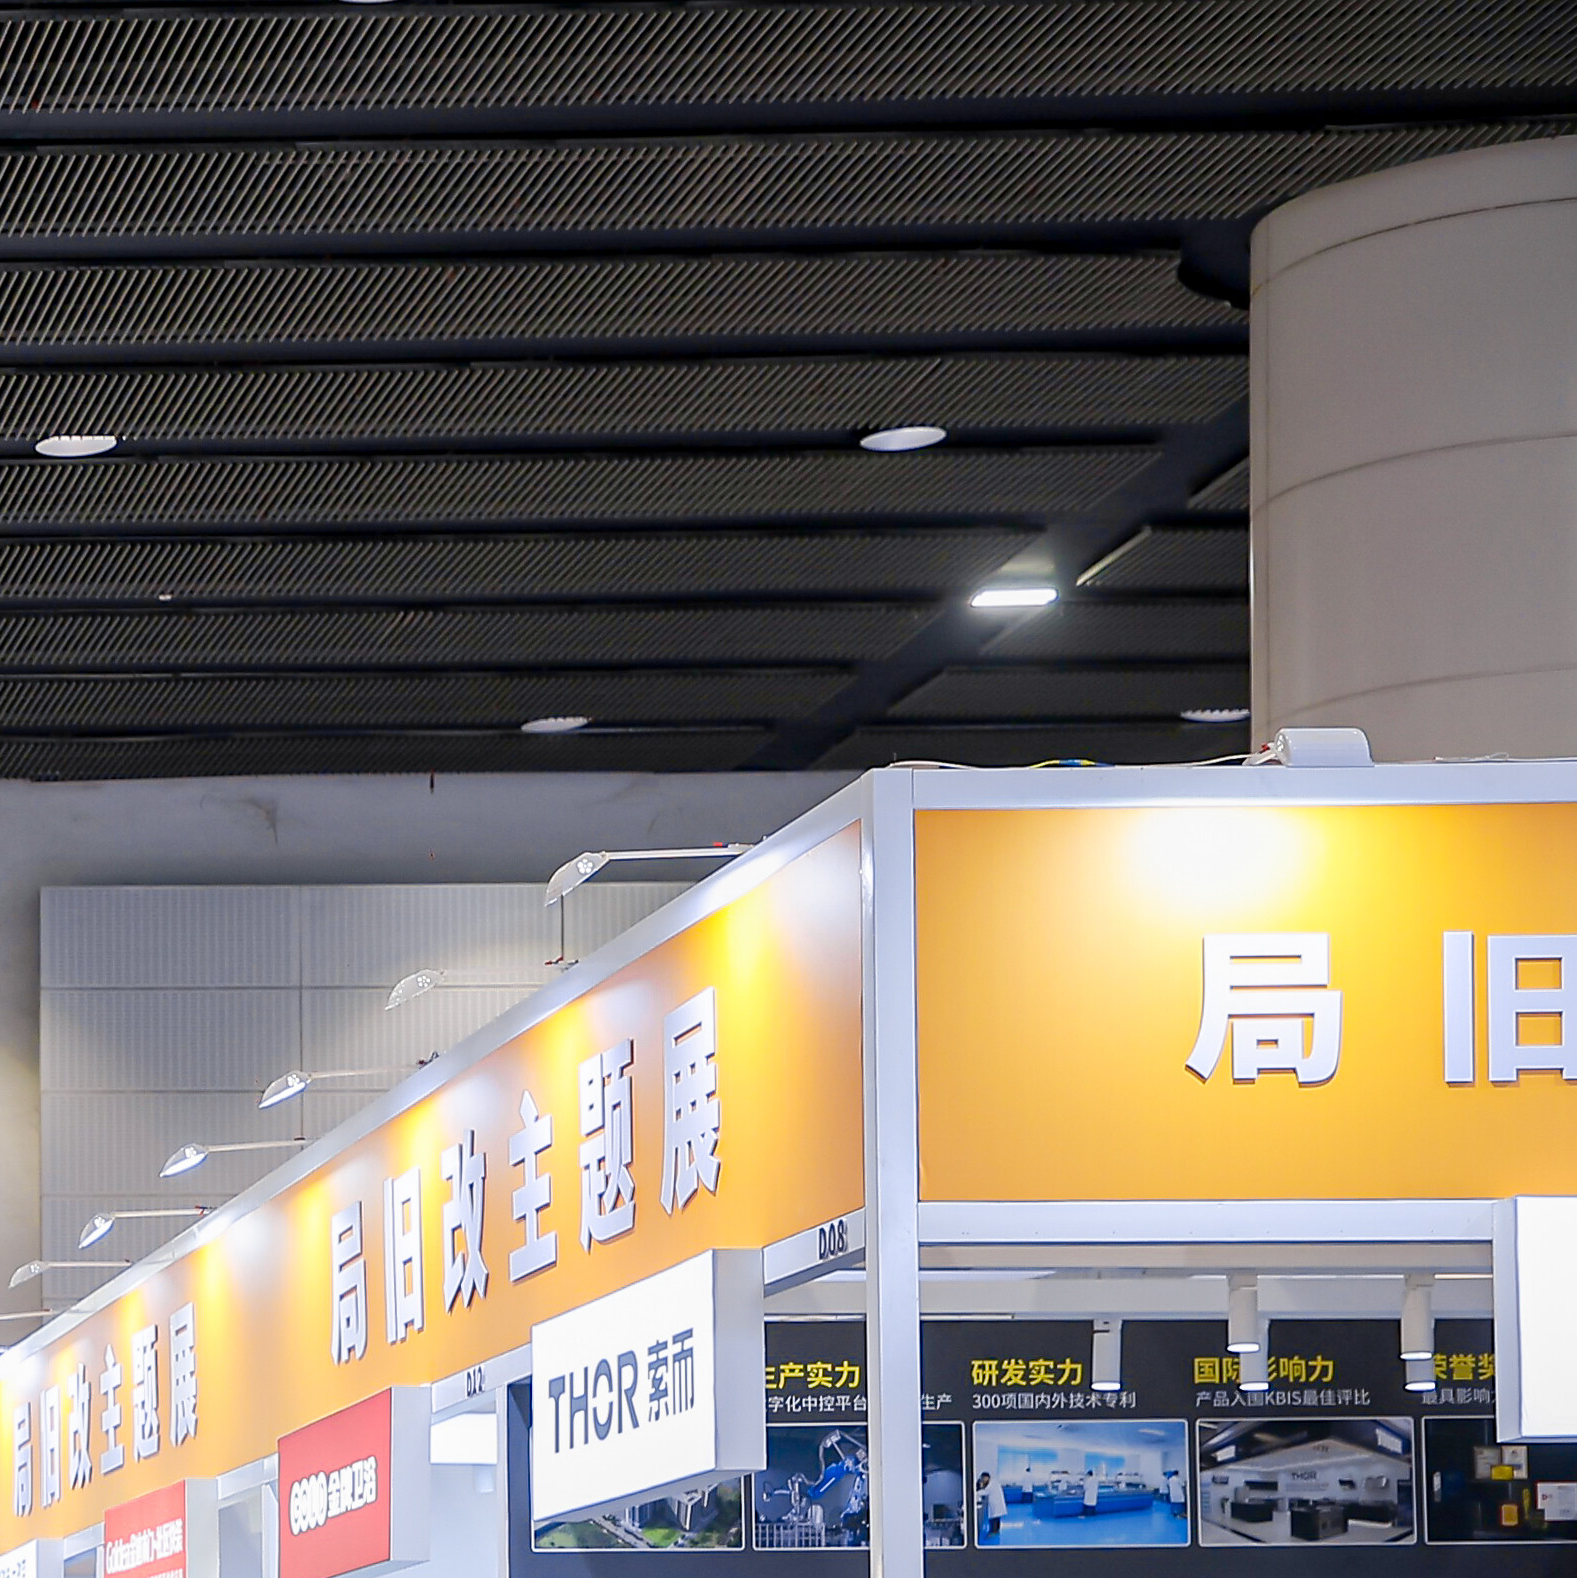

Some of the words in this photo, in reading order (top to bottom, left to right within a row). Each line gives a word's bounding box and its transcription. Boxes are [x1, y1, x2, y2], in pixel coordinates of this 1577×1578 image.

[330, 986, 720, 1366] 局旧改主题展
[819, 1219, 848, 1260] D08
[548, 1350, 640, 1454] THOR
[647, 1327, 694, 1423] 索而
[971, 1358, 1084, 1387] 研发实力
[12, 1302, 199, 1518] 局旧改主题展
[766, 1394, 867, 1413] 字化中控平台
[1421, 1387, 1495, 1406] 最具影响
